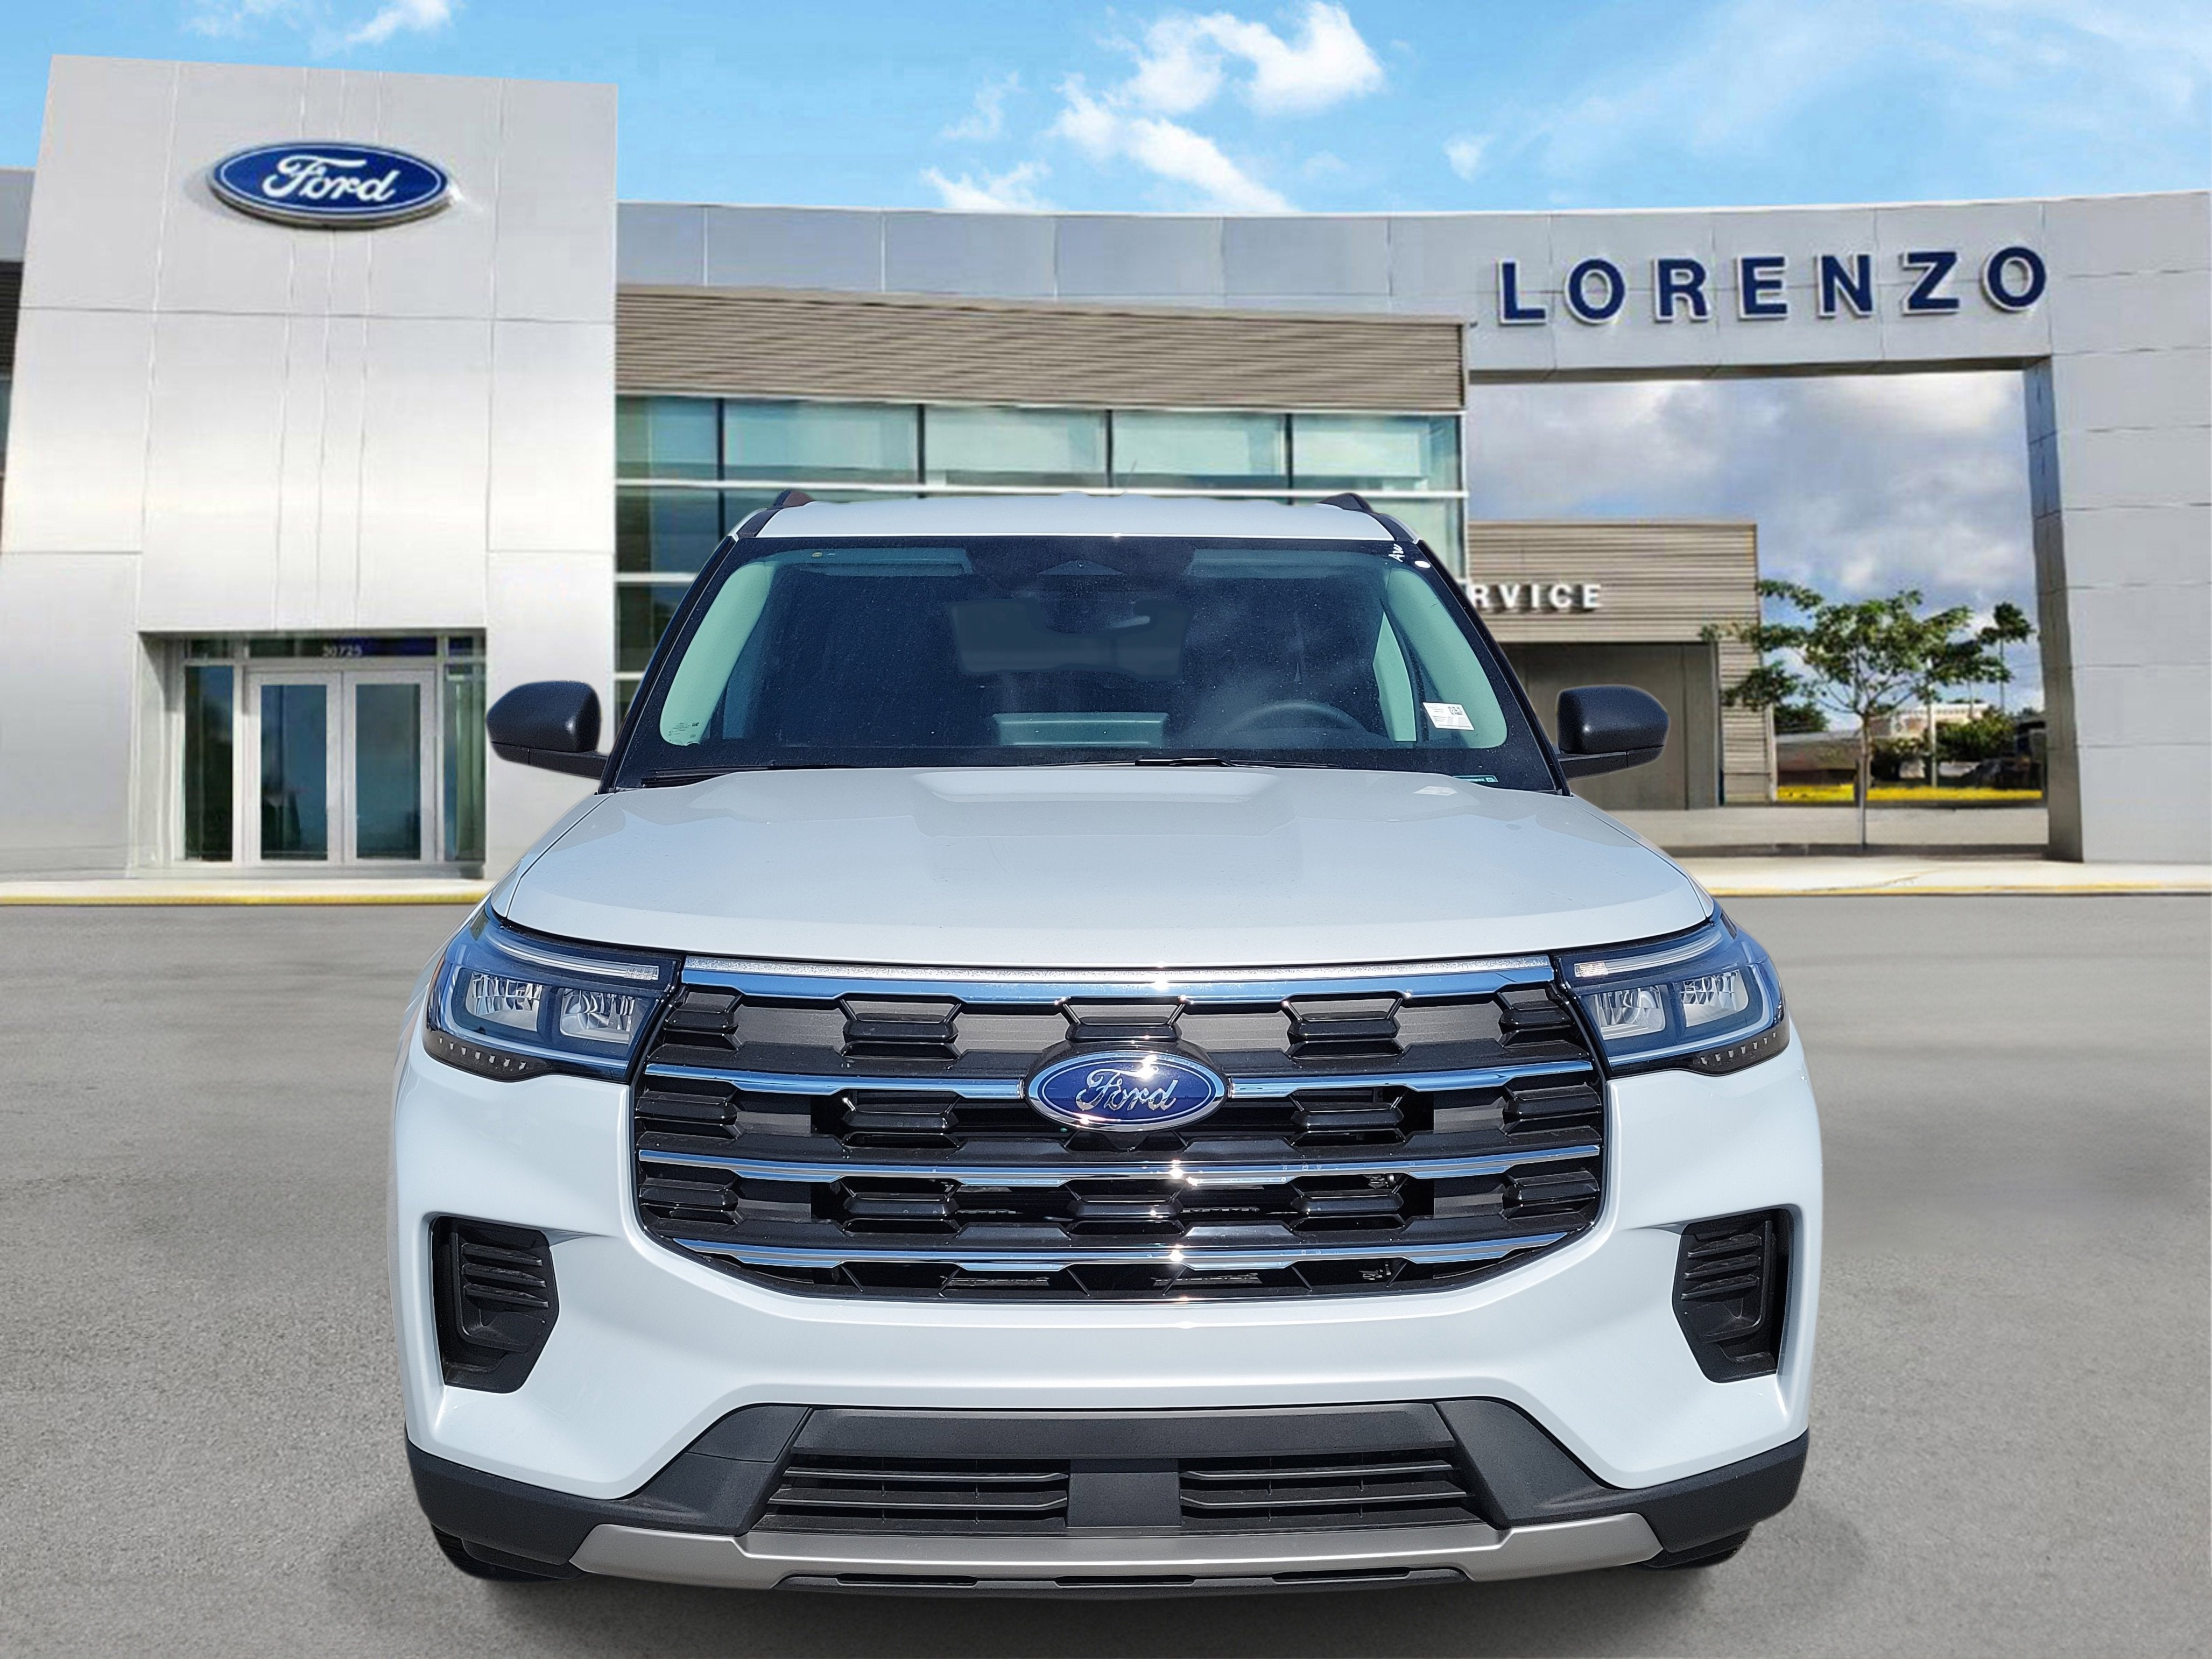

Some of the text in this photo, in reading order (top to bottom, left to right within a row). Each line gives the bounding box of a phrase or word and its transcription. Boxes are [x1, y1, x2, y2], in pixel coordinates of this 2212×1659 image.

[262, 154, 400, 202] Ford
[1497, 246, 2046, 324] LORENZO
[1075, 1068, 1179, 1111] Ford
